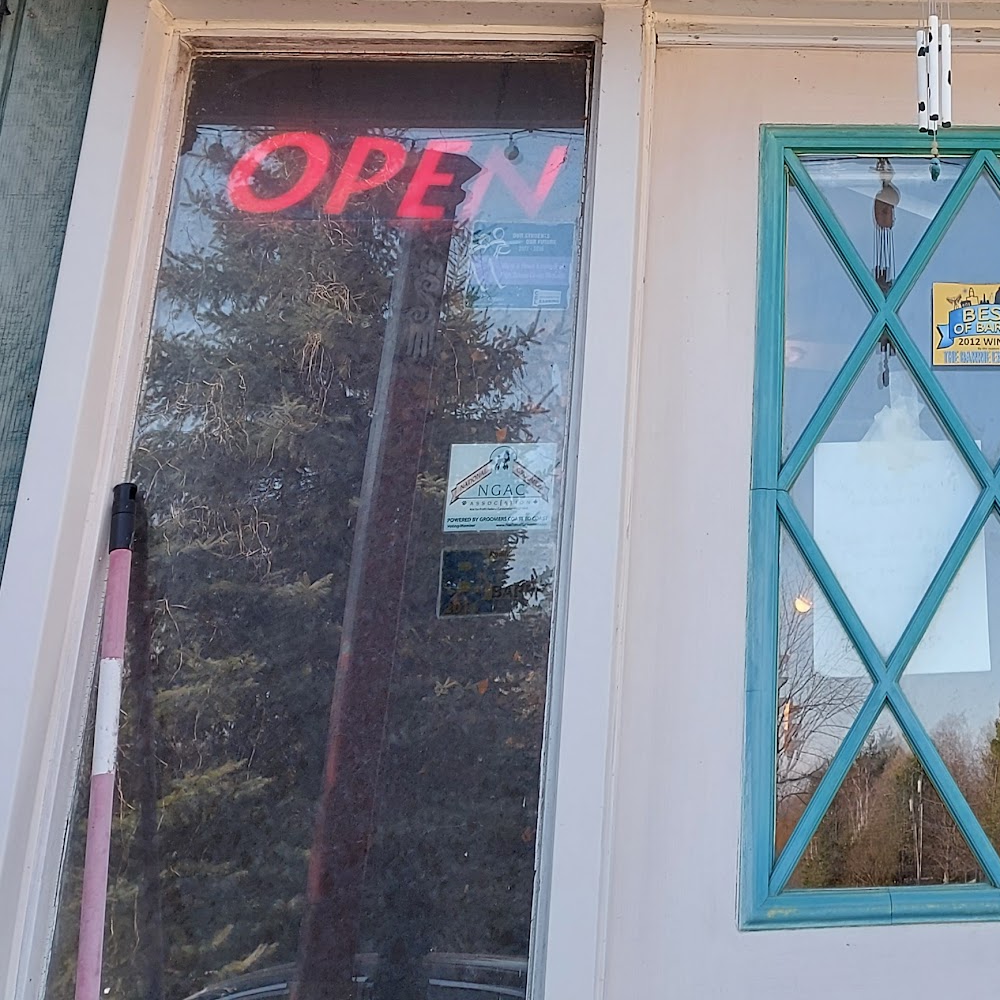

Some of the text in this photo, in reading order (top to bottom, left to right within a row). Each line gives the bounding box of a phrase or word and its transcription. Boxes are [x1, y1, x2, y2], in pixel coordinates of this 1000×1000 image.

[226, 130, 569, 220] OPEN
[953, 323, 972, 334] OF
[958, 338, 981, 346] 2012
[944, 351, 959, 364] THE
[960, 351, 990, 364] BARRIE
[477, 484, 526, 497] NGAC
